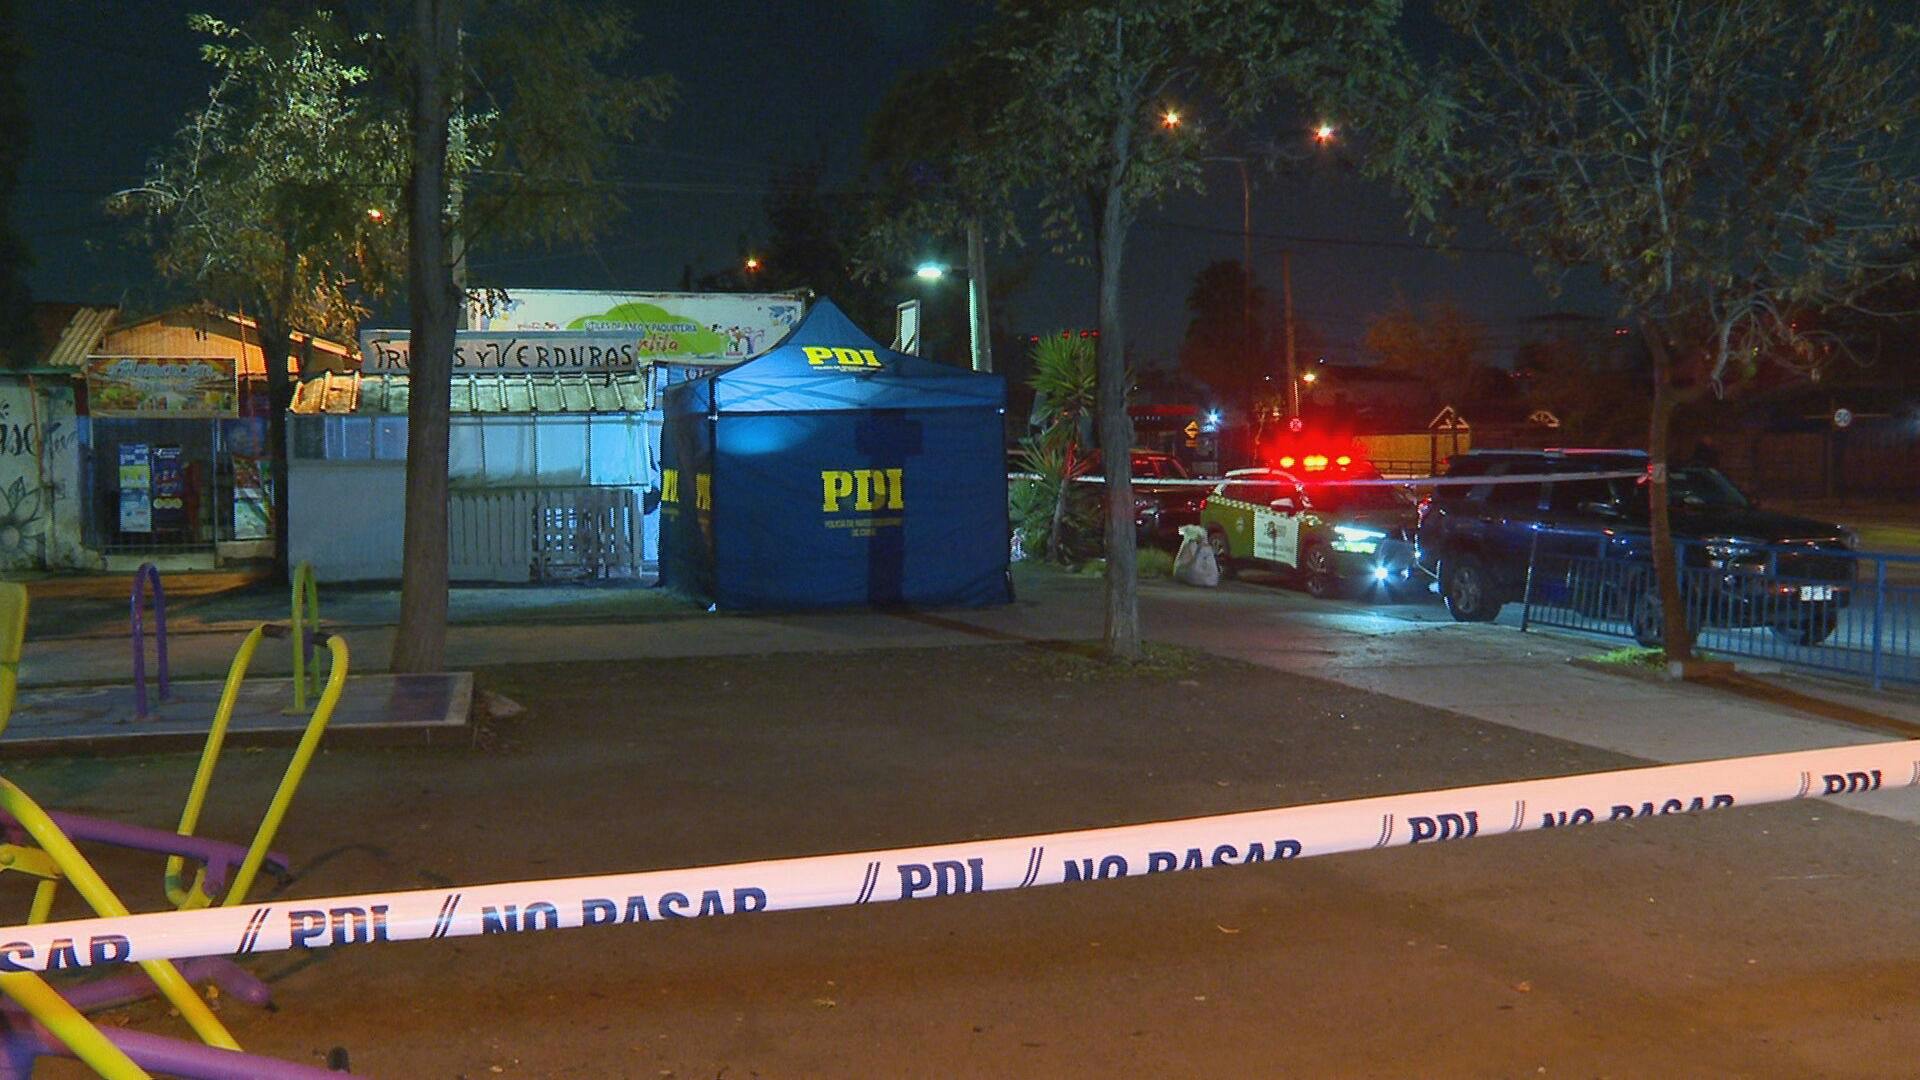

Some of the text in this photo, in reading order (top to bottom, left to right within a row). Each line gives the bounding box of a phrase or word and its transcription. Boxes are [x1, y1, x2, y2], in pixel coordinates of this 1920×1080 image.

[487, 338, 632, 368] VERDURAS
[802, 346, 882, 367] PDI
[821, 468, 904, 512] PDI
[289, 904, 389, 949] PDI
[897, 857, 984, 900] PDI
